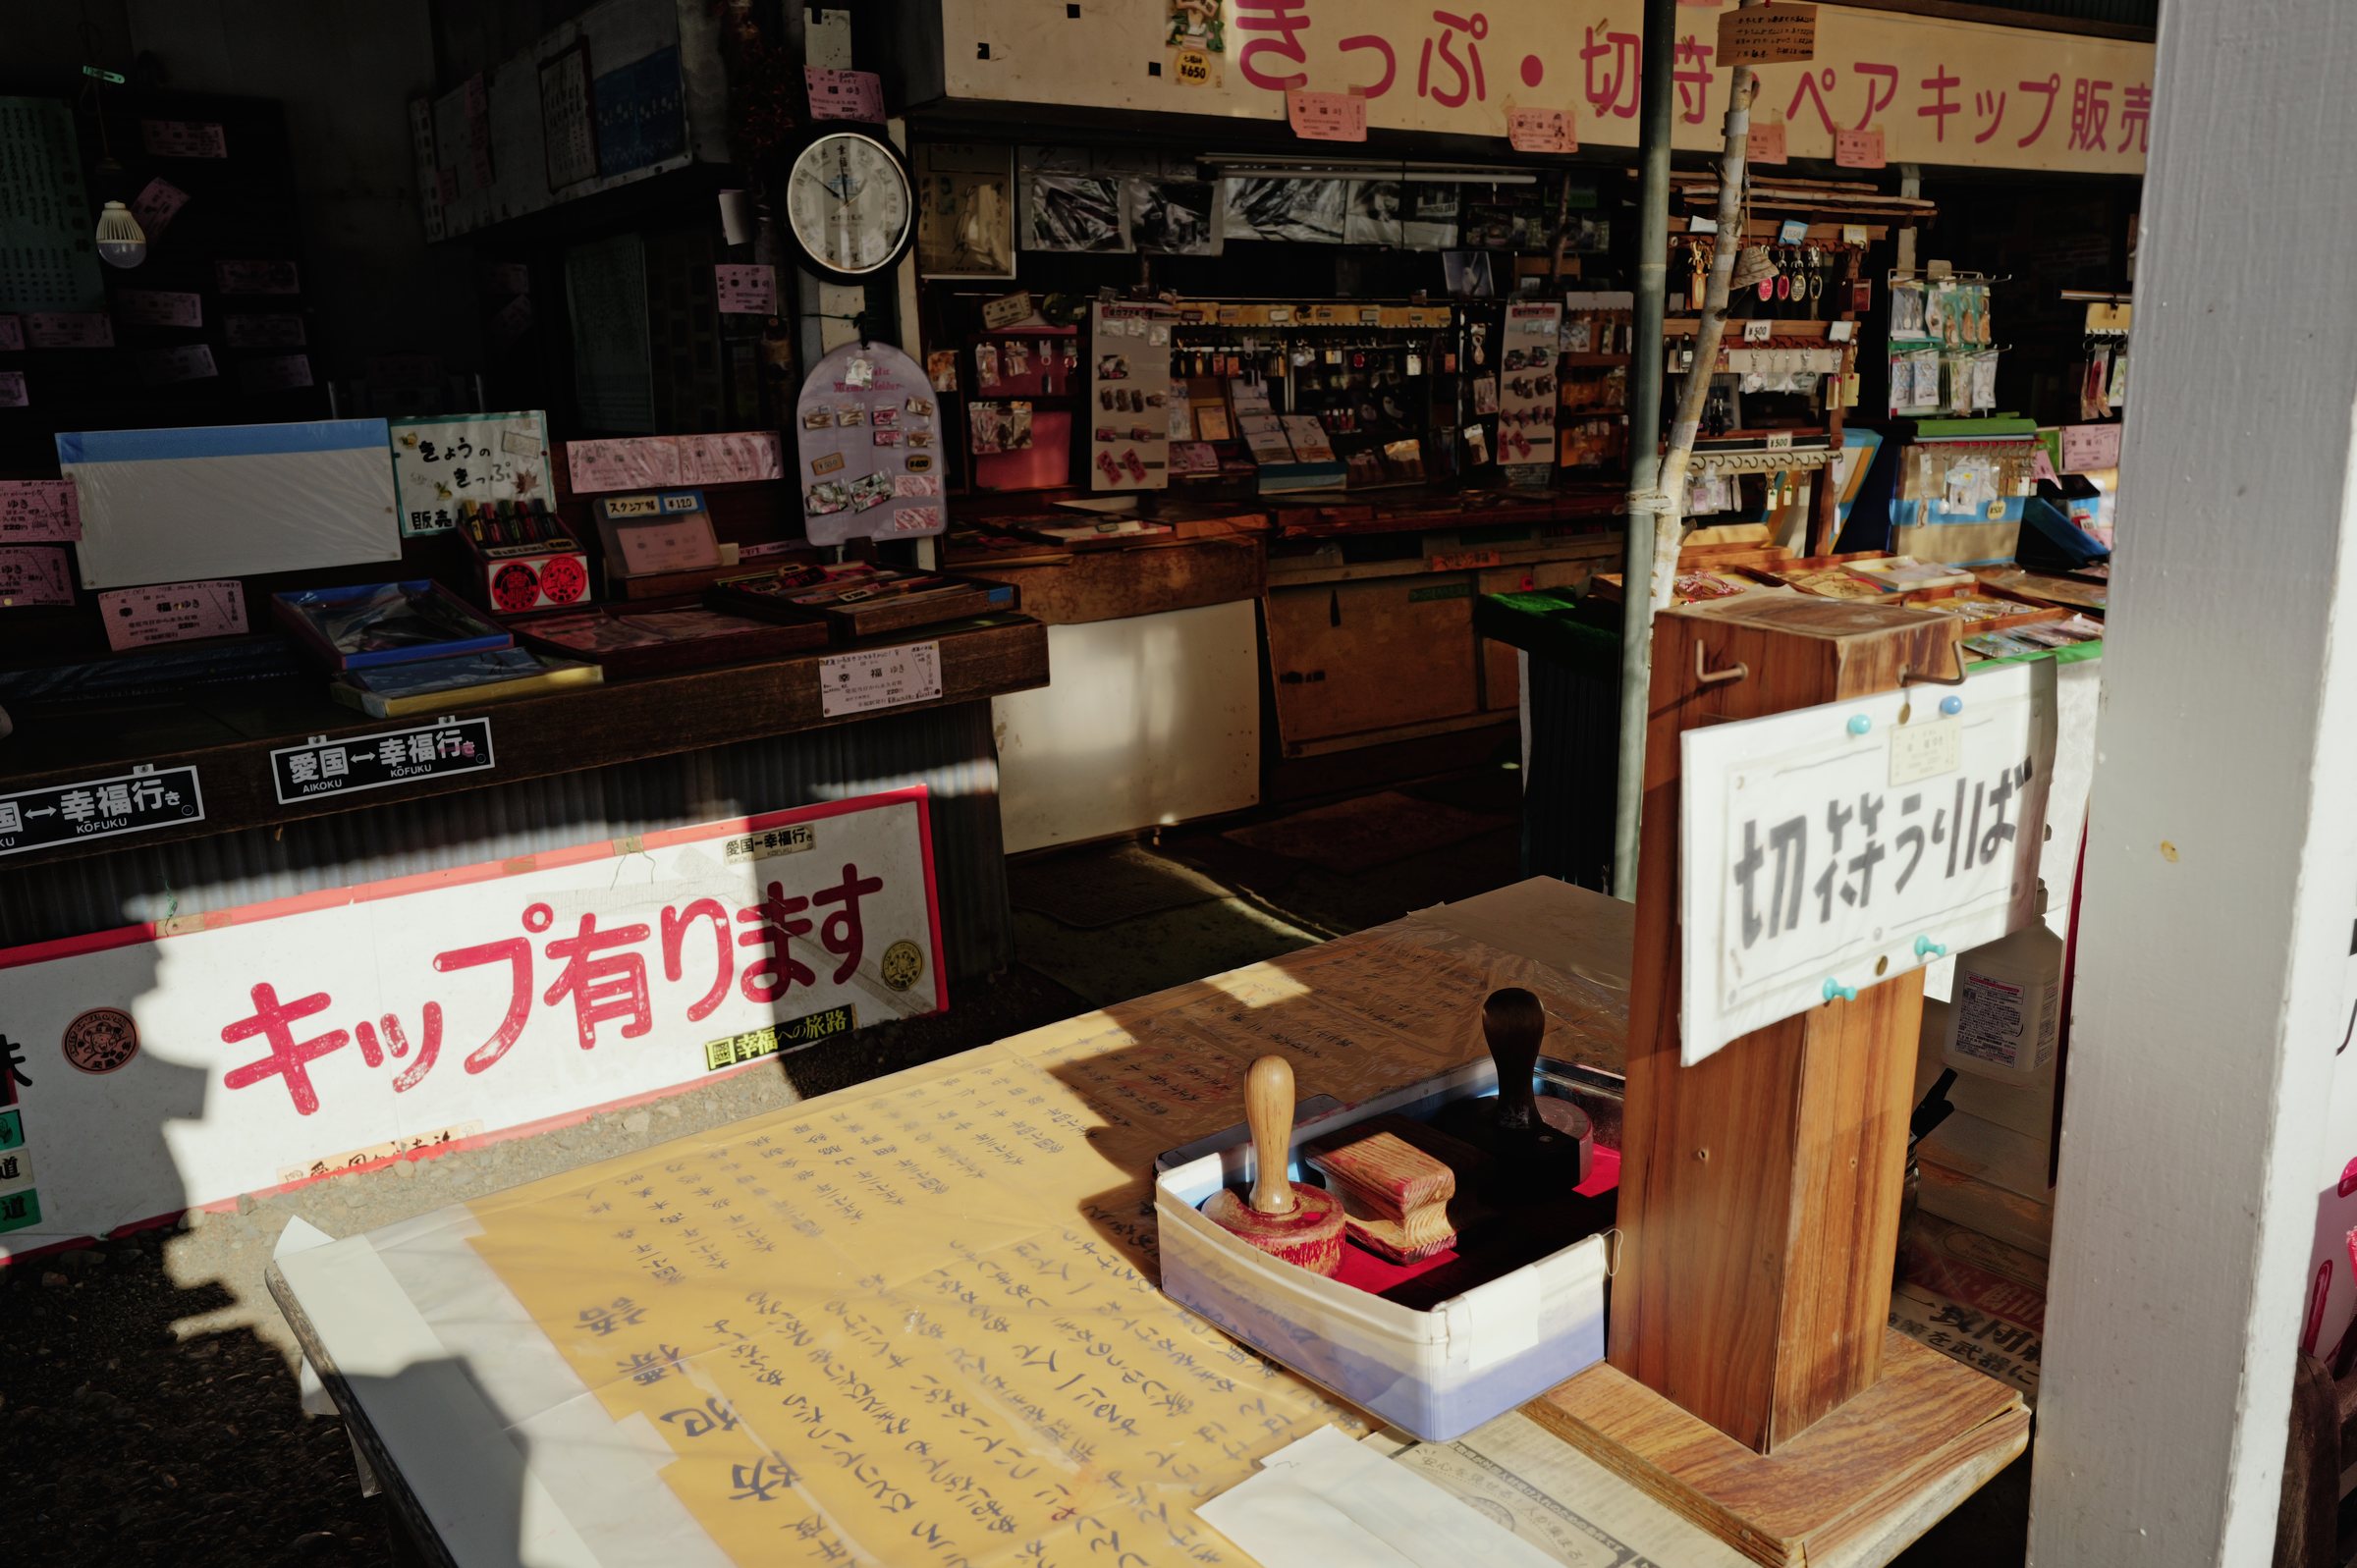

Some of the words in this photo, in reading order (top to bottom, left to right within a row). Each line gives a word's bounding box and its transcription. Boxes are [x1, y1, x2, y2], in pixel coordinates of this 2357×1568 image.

[1181, 64, 1206, 79] ¥650
[418, 437, 491, 462] きょうの
[454, 461, 512, 489] きっぷ
[1770, 438, 1789, 449] ¥500
[668, 498, 692, 510] ¥120
[289, 746, 351, 784] 愛国
[378, 730, 476, 769] 幸福行き
[302, 778, 345, 794] AIKOKU
[61, 779, 181, 825] 幸福行き
[1733, 754, 2034, 951] 切符うりば
[220, 861, 885, 1116] キップ有ります
[737, 1009, 848, 1059] 幸福への旅路
[949, 1240, 1051, 1309] しめましょう
[1014, 1242, 1093, 1295] 一人では
[1063, 1232, 1155, 1293] ひろげよう
[923, 1270, 1011, 1333] あるかない
[703, 1319, 787, 1386] あぶないよ
[824, 1302, 912, 1370] すぐにげる
[1052, 1317, 1194, 1418] 家じゅうのかぎ
[1092, 1301, 1235, 1393] かぎをかけてね
[575, 1296, 802, 1502] 防犯標語
[807, 1349, 909, 1435] みぎとひだりを
[1012, 1344, 1140, 1436] よるに一人で
[1238, 1397, 1303, 1445] ばん
[781, 1393, 917, 1514] ひとりでいったら
[909, 1375, 1038, 1480] ついていかない
[904, 1439, 1018, 1535] あおになっても
